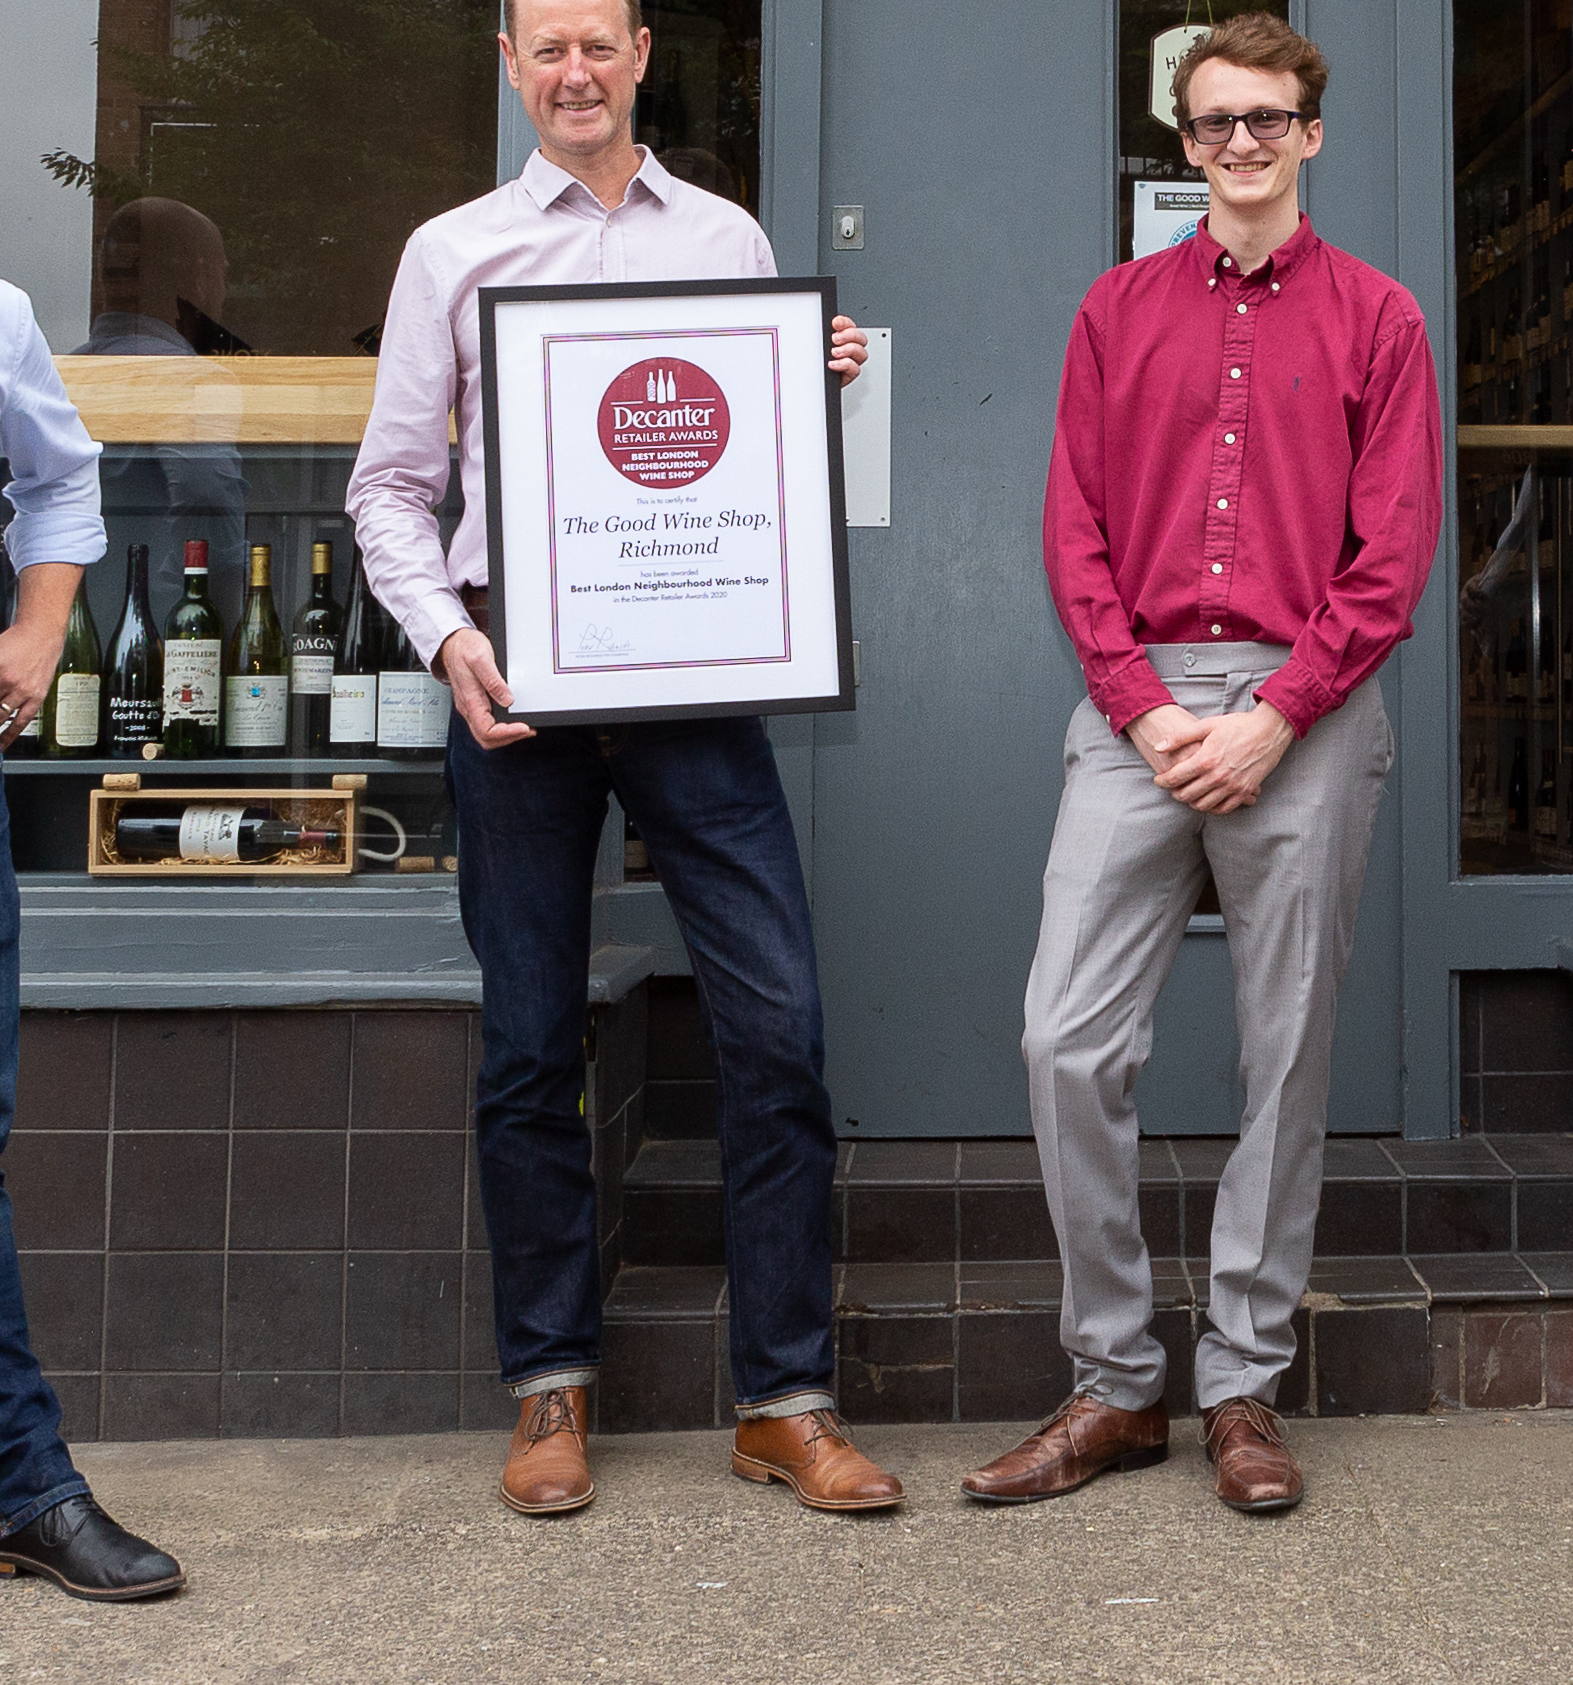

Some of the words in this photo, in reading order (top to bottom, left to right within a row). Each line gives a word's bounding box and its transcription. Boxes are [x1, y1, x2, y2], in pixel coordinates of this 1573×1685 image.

[1157, 194, 1174, 202] THE
[1171, 222, 1197, 247] PREVEN
[613, 404, 715, 430] Decanter
[614, 432, 667, 444] RETAILER
[668, 430, 718, 441] AWARDS
[631, 452, 656, 461] BEST
[657, 450, 699, 460] LONDON
[622, 460, 709, 472] NEIGHBOURHOOD
[639, 472, 667, 481] WINE
[668, 470, 695, 480] SHOP
[563, 516, 599, 535] The
[604, 513, 657, 532] Good
[663, 512, 713, 530] Wine
[717, 509, 772, 531] Shop,
[618, 536, 720, 559] Richmond
[570, 585, 591, 594] Best
[594, 583, 631, 592] London
[634, 578, 713, 593] Neighbourhood
[715, 577, 741, 587] Wine
[744, 575, 769, 587] Shop
